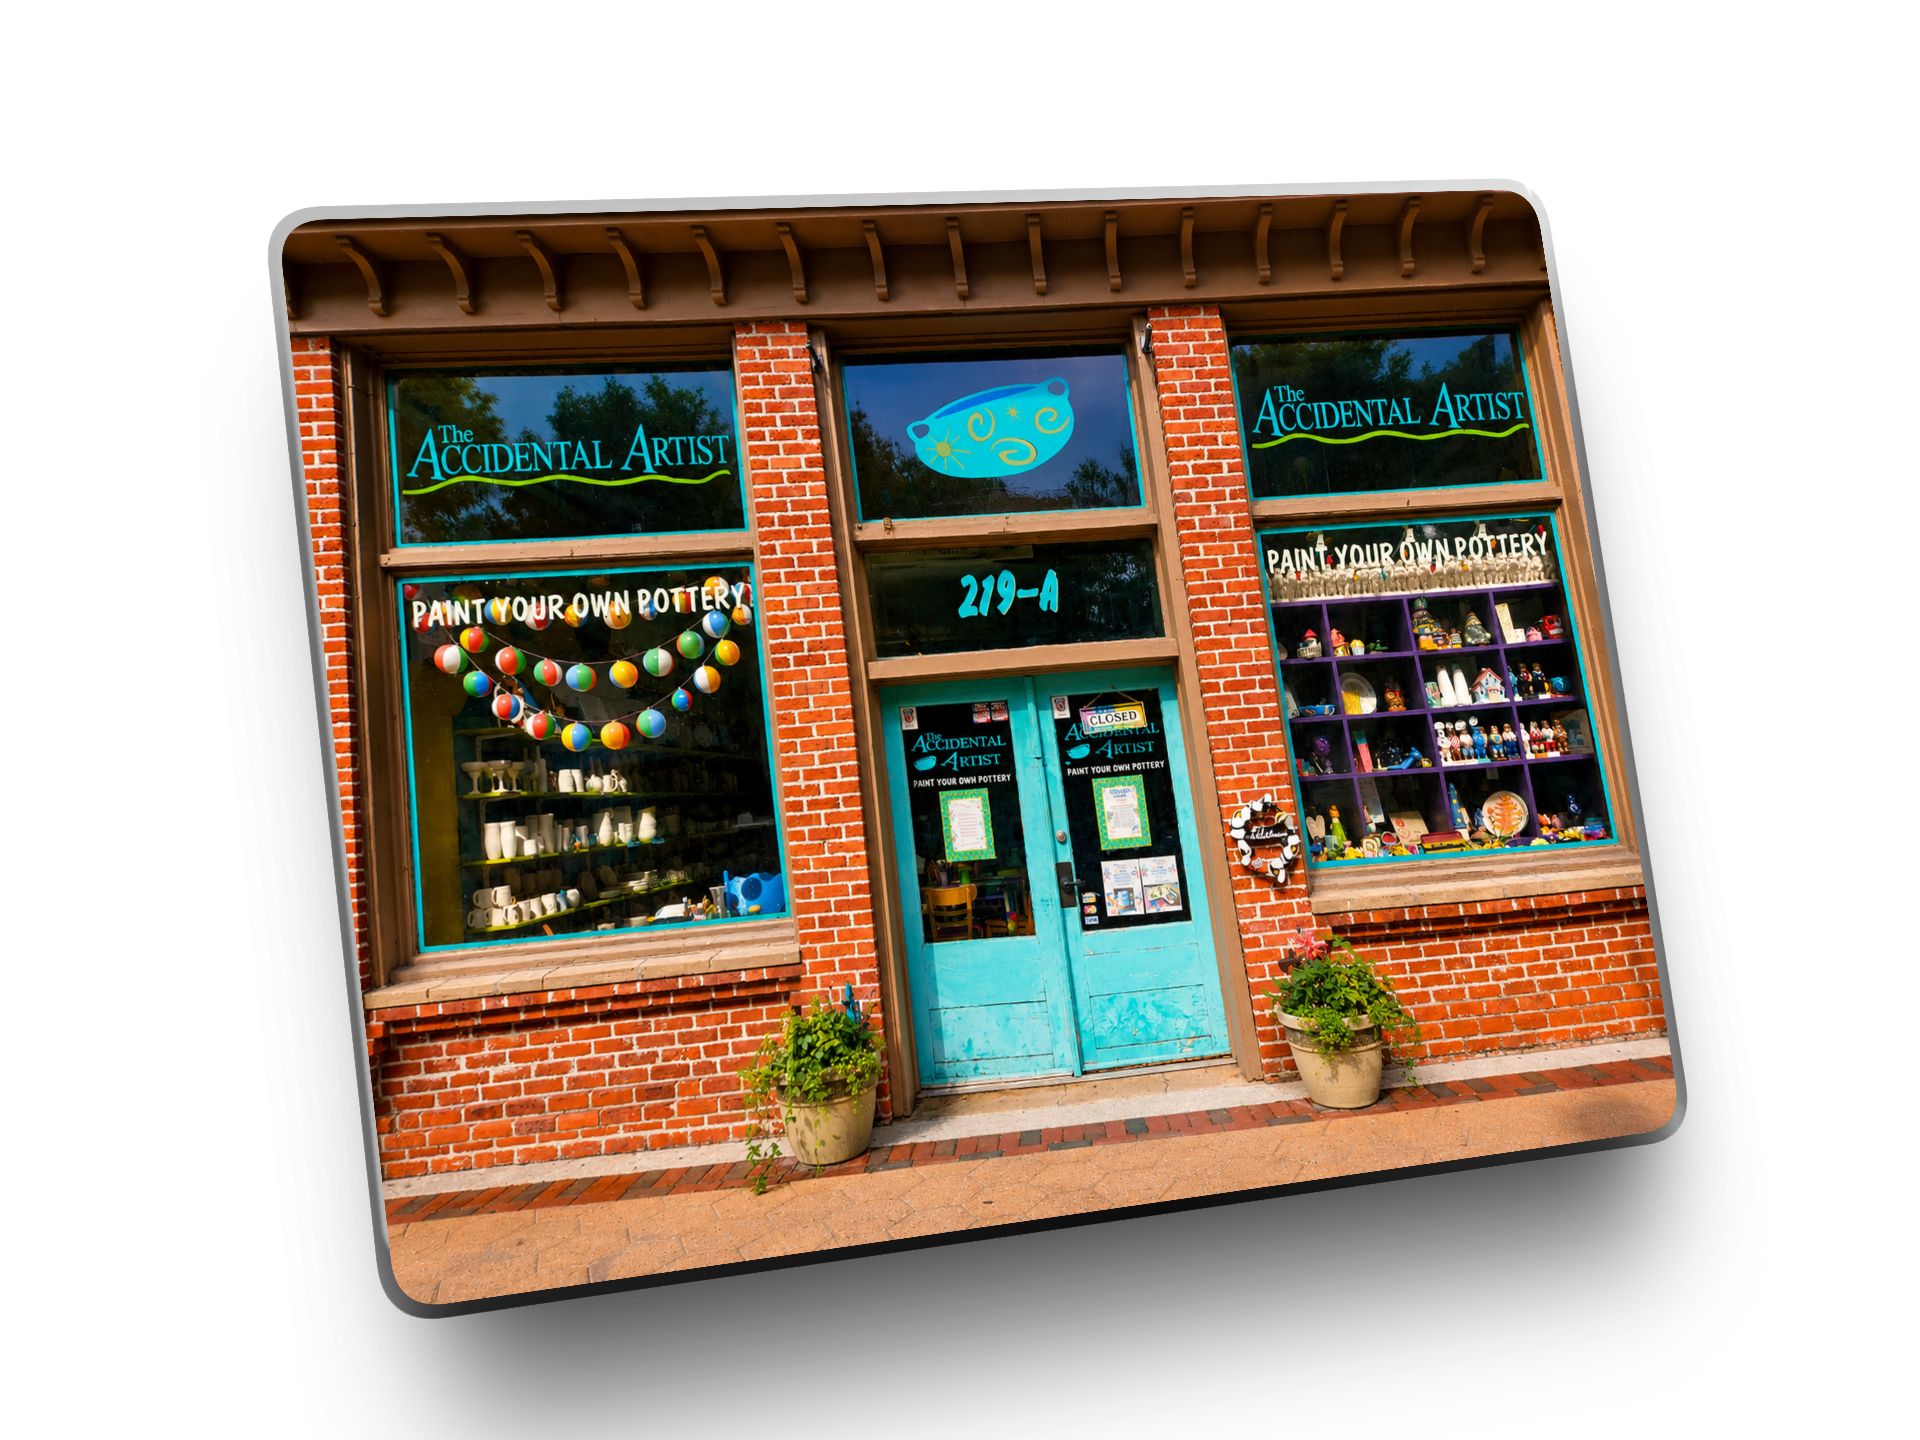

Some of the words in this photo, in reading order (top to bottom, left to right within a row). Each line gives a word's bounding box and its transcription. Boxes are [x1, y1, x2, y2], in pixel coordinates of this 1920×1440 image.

[1274, 385, 1305, 402] The
[1252, 388, 1421, 437] ACCIDENTAL
[1428, 382, 1525, 429] ARTIST
[438, 424, 473, 443] The
[406, 428, 613, 481] ACCIDENTAL
[620, 424, 731, 474] ARTIST
[1267, 547, 1329, 574] PAINT
[1335, 542, 1395, 569] YOUR
[1400, 538, 1451, 566] OWN
[1455, 531, 1547, 560] POTTERY
[958, 568, 1059, 618] 219-A
[412, 597, 486, 628] PAINT
[490, 593, 565, 622] YOUR
[572, 590, 631, 618] OWN
[637, 584, 745, 614] POTTERY
[1089, 710, 1137, 726] CLOSED
[911, 734, 1007, 753] ACCIDENTAL
[924, 732, 942, 741] The
[1095, 739, 1155, 759] ARTIST
[940, 751, 1001, 771] ARTIST
[1067, 766, 1089, 776] PAINT
[1090, 764, 1112, 774] YOUR
[1113, 763, 1131, 772] OWN
[1132, 760, 1165, 770] POTTERY
[913, 778, 935, 788] PAINT
[936, 777, 957, 786] YOUR
[959, 776, 977, 785] OWN
[978, 773, 1012, 783] POTTERY
